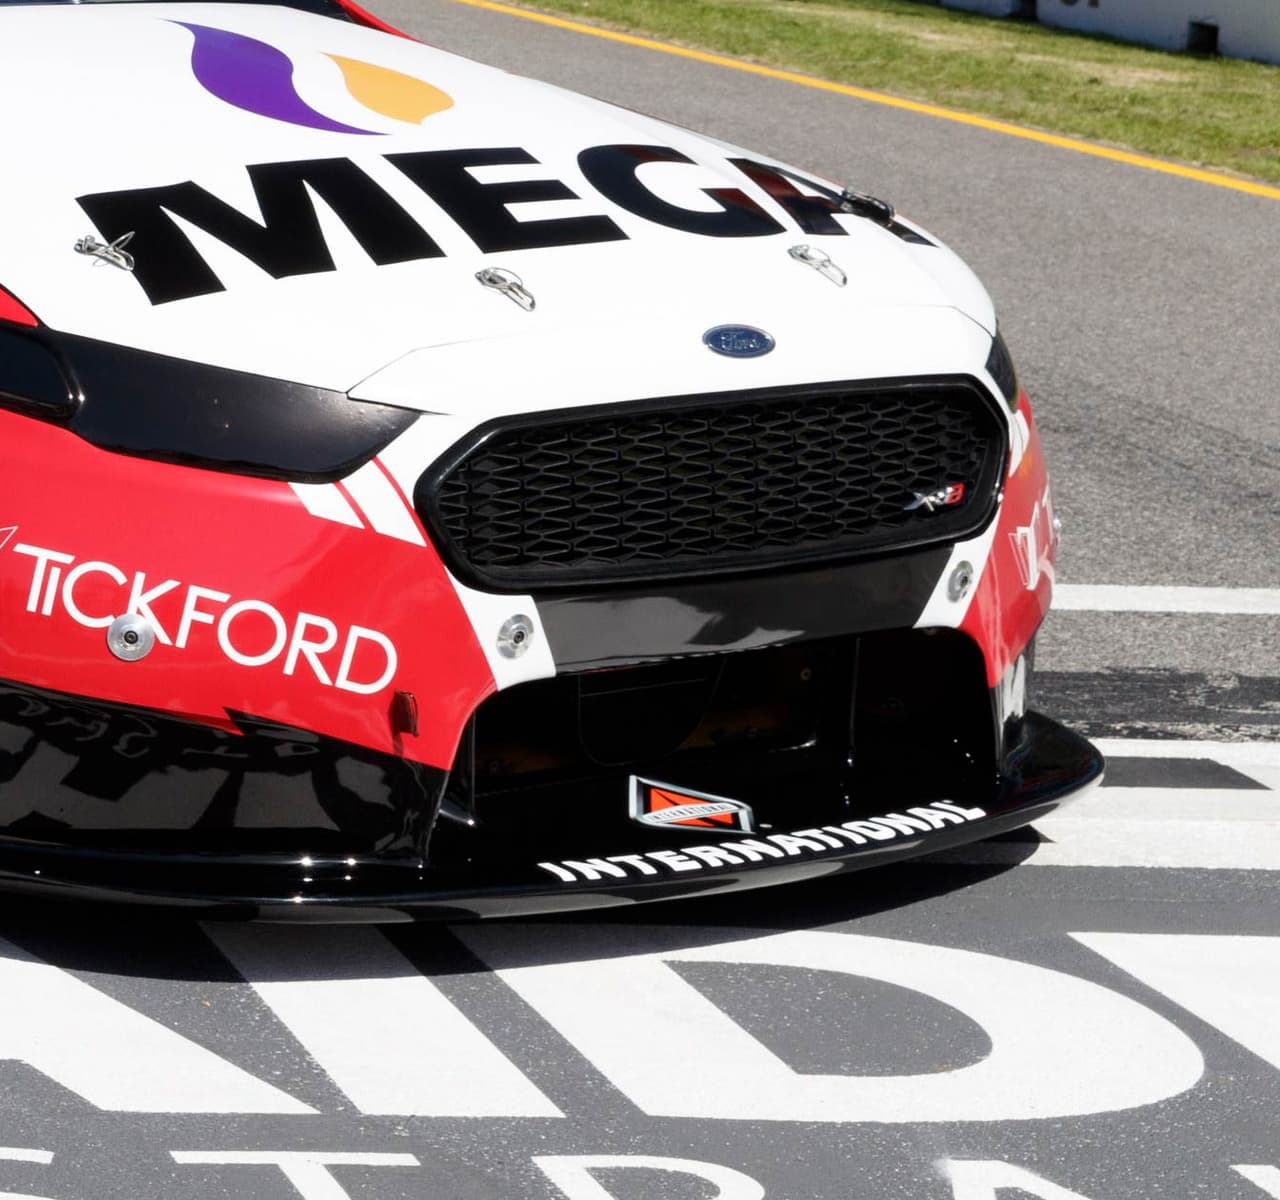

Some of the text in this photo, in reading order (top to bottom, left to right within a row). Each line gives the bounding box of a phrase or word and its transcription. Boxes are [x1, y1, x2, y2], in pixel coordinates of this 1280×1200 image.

[74, 145, 938, 306] MEGA
[14, 543, 398, 694] TICKFORD
[538, 800, 986, 883] INTERNATIONAL
